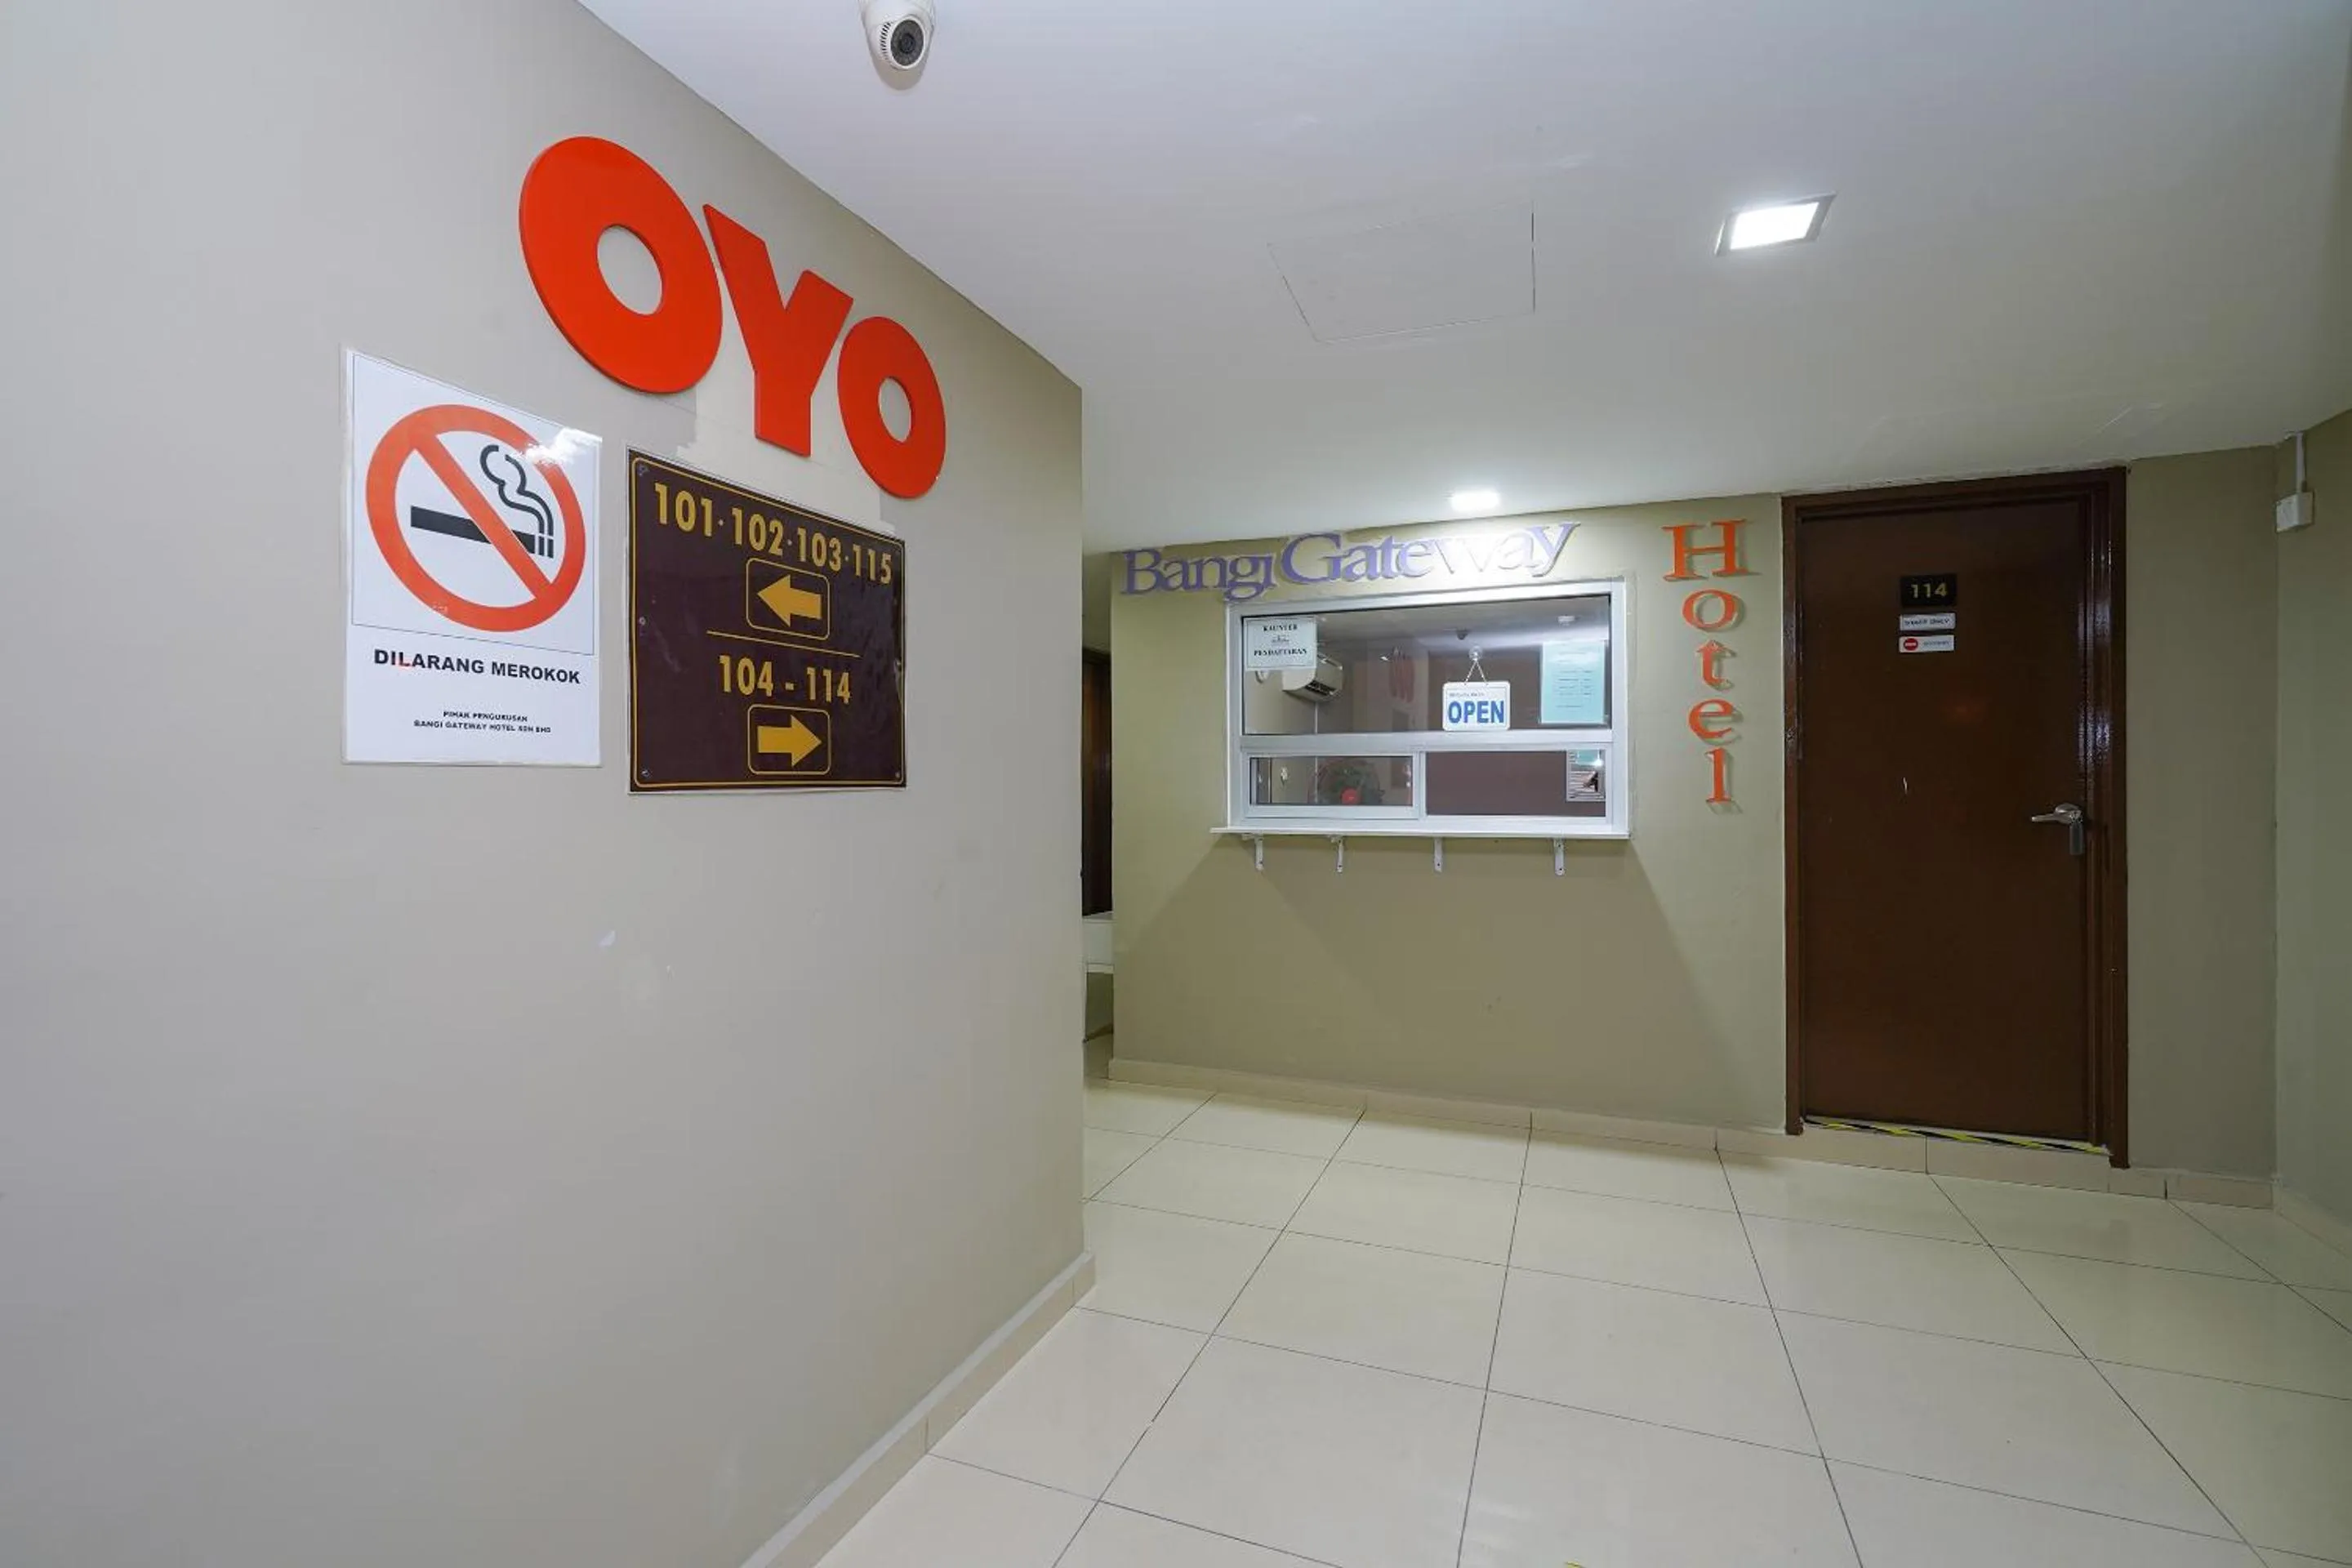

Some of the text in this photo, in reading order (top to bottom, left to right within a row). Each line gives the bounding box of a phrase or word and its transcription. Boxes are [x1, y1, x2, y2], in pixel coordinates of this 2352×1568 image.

[519, 136, 947, 500] OYO
[1280, 523, 1581, 586] Gateway
[1911, 582, 1947, 599] 114
[373, 648, 581, 684] DILARANG MEROKOK
[719, 654, 773, 697] 104
[806, 666, 850, 704] 114
[413, 719, 443, 728] BANGI
[444, 721, 487, 731] GATEWAY
[489, 724, 516, 733] HOTEL
[1448, 700, 1504, 724] OPEN
